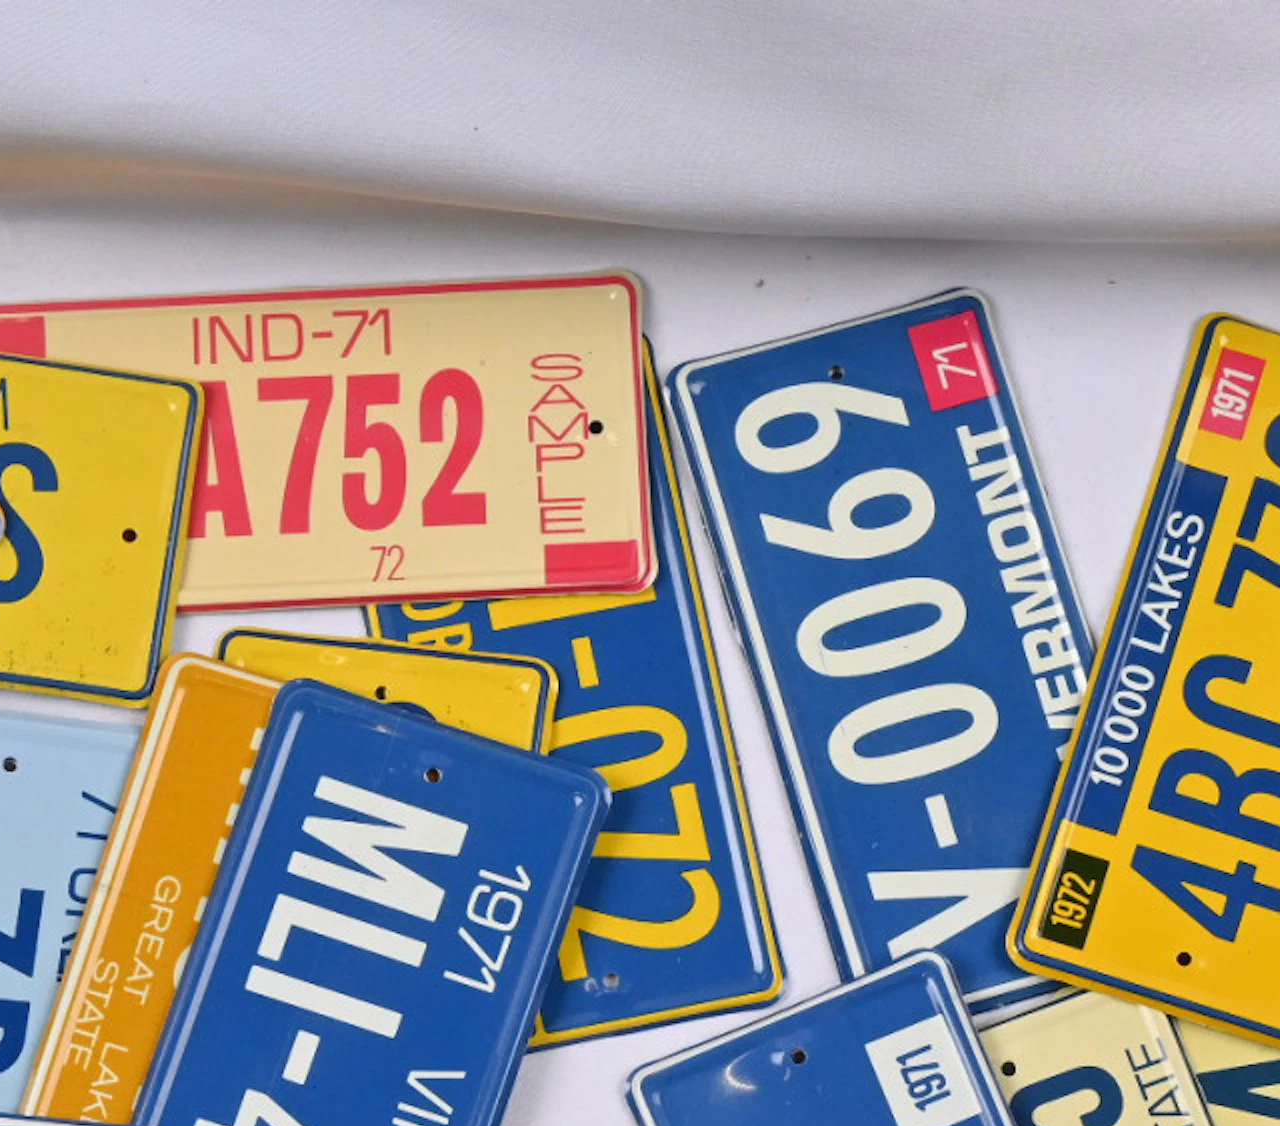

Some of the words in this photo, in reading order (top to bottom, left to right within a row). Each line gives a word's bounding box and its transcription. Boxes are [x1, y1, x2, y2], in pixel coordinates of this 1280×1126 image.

[192, 309, 392, 364] IND-71
[935, 342, 977, 391] 71
[1211, 367, 1255, 422] 1971
[527, 353, 589, 534] SAMPLE
[370, 545, 405, 583] 72
[1138, 510, 1205, 655] LAKES
[444, 864, 531, 992] 1971
[1051, 870, 1095, 931] 1972
[120, 875, 181, 1005] GREAT
[66, 957, 120, 1070] STATE
[79, 1044, 128, 1122] LAK
[897, 1044, 951, 1113] 1971
